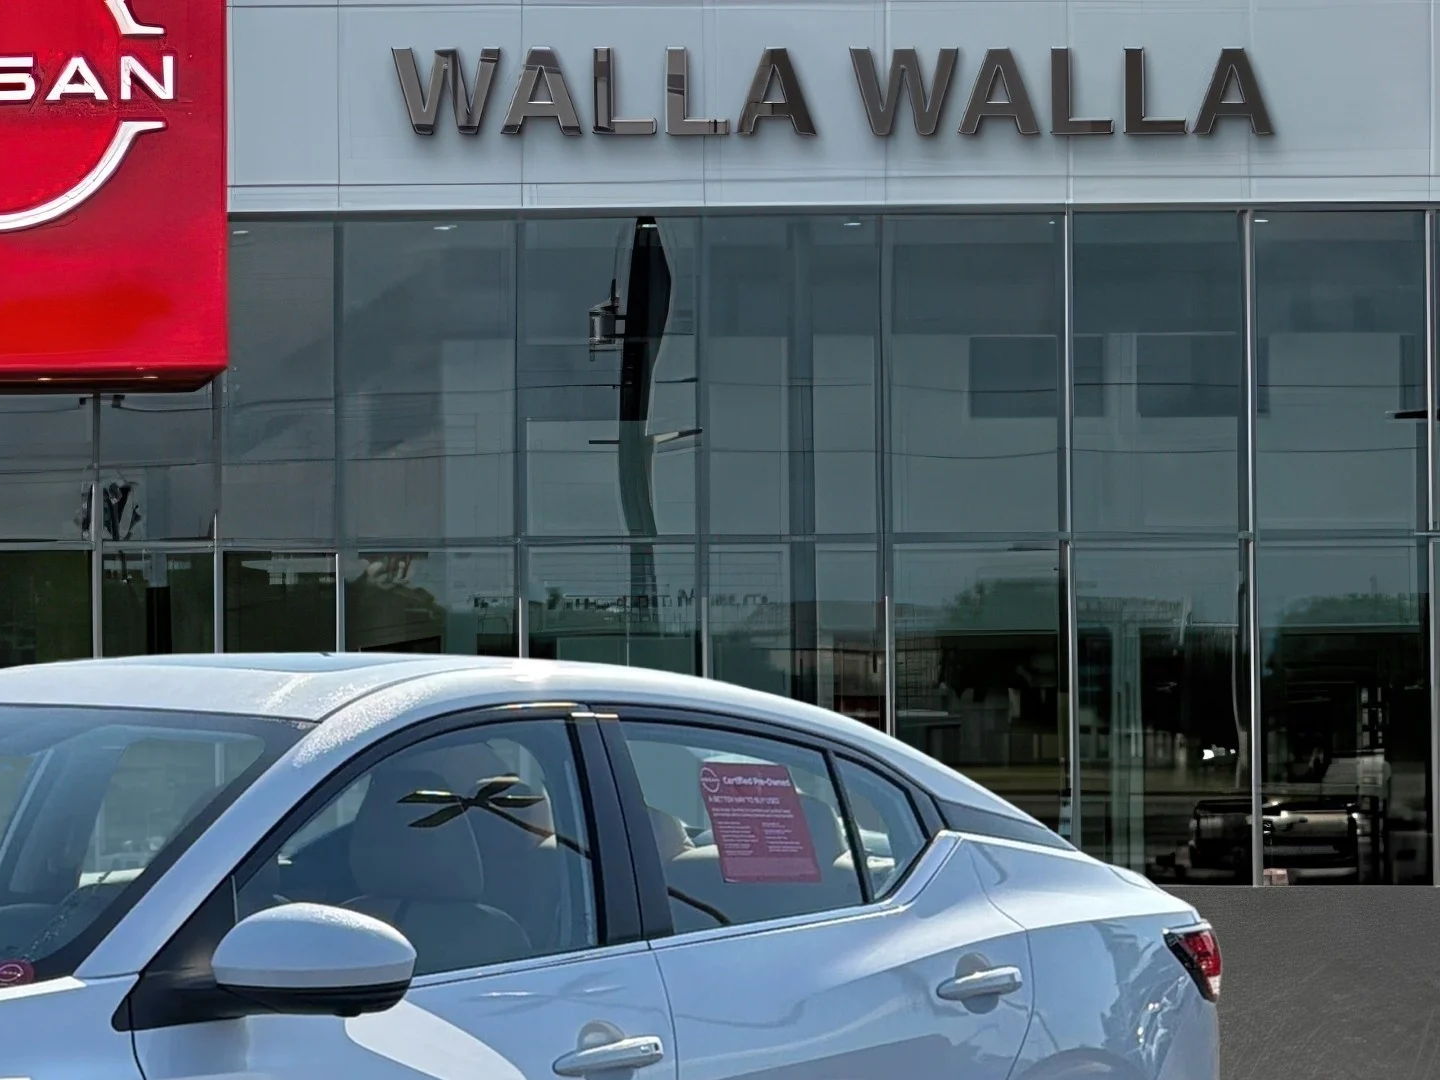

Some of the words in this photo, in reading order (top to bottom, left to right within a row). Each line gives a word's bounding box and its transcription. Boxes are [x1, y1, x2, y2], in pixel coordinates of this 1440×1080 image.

[391, 46, 817, 136] WALLA
[848, 46, 1274, 136] WALLA
[722, 776, 752, 785] Certified
[753, 777, 791, 787] Pre-Owned
